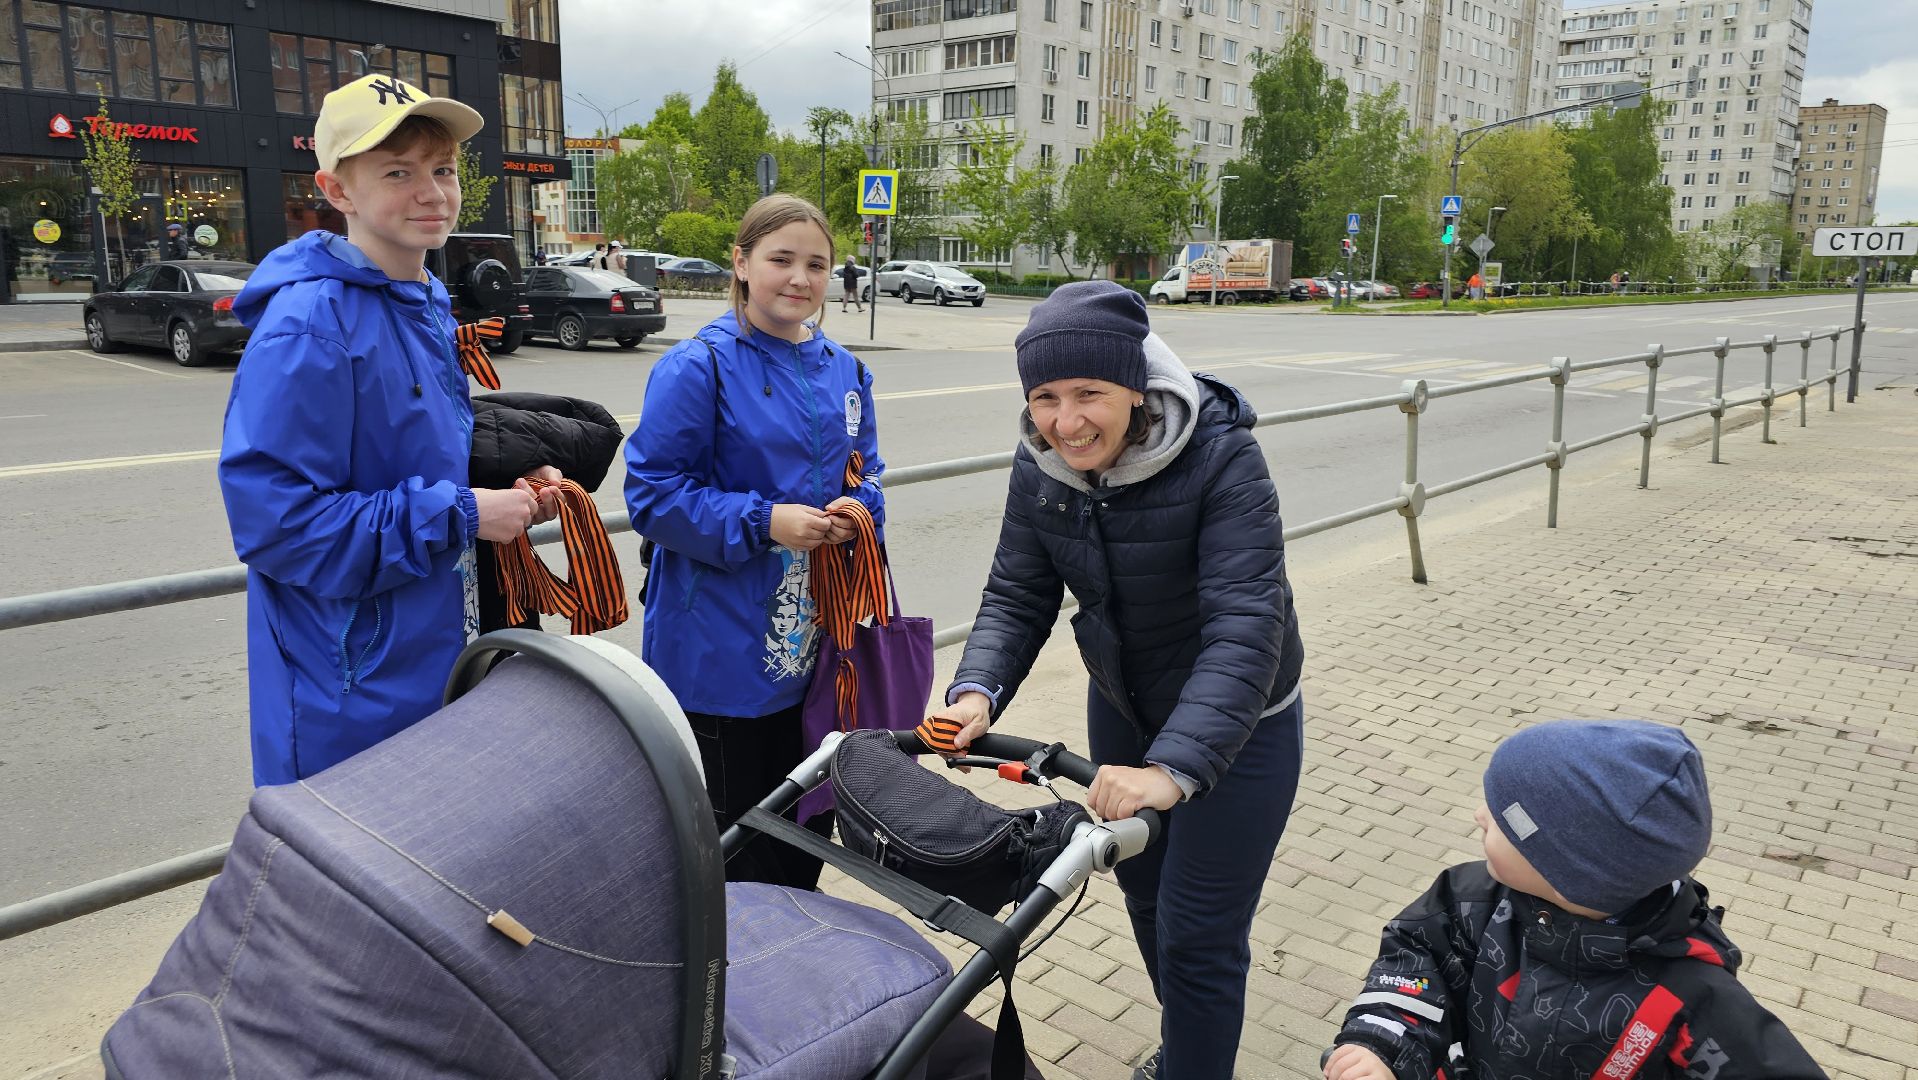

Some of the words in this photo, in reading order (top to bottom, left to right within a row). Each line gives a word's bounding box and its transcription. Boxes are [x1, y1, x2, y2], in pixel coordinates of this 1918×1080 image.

[369, 79, 415, 105] NY
[527, 163, 554, 173] ДЕТЕЙ
[1830, 232, 1904, 251] СТОП
